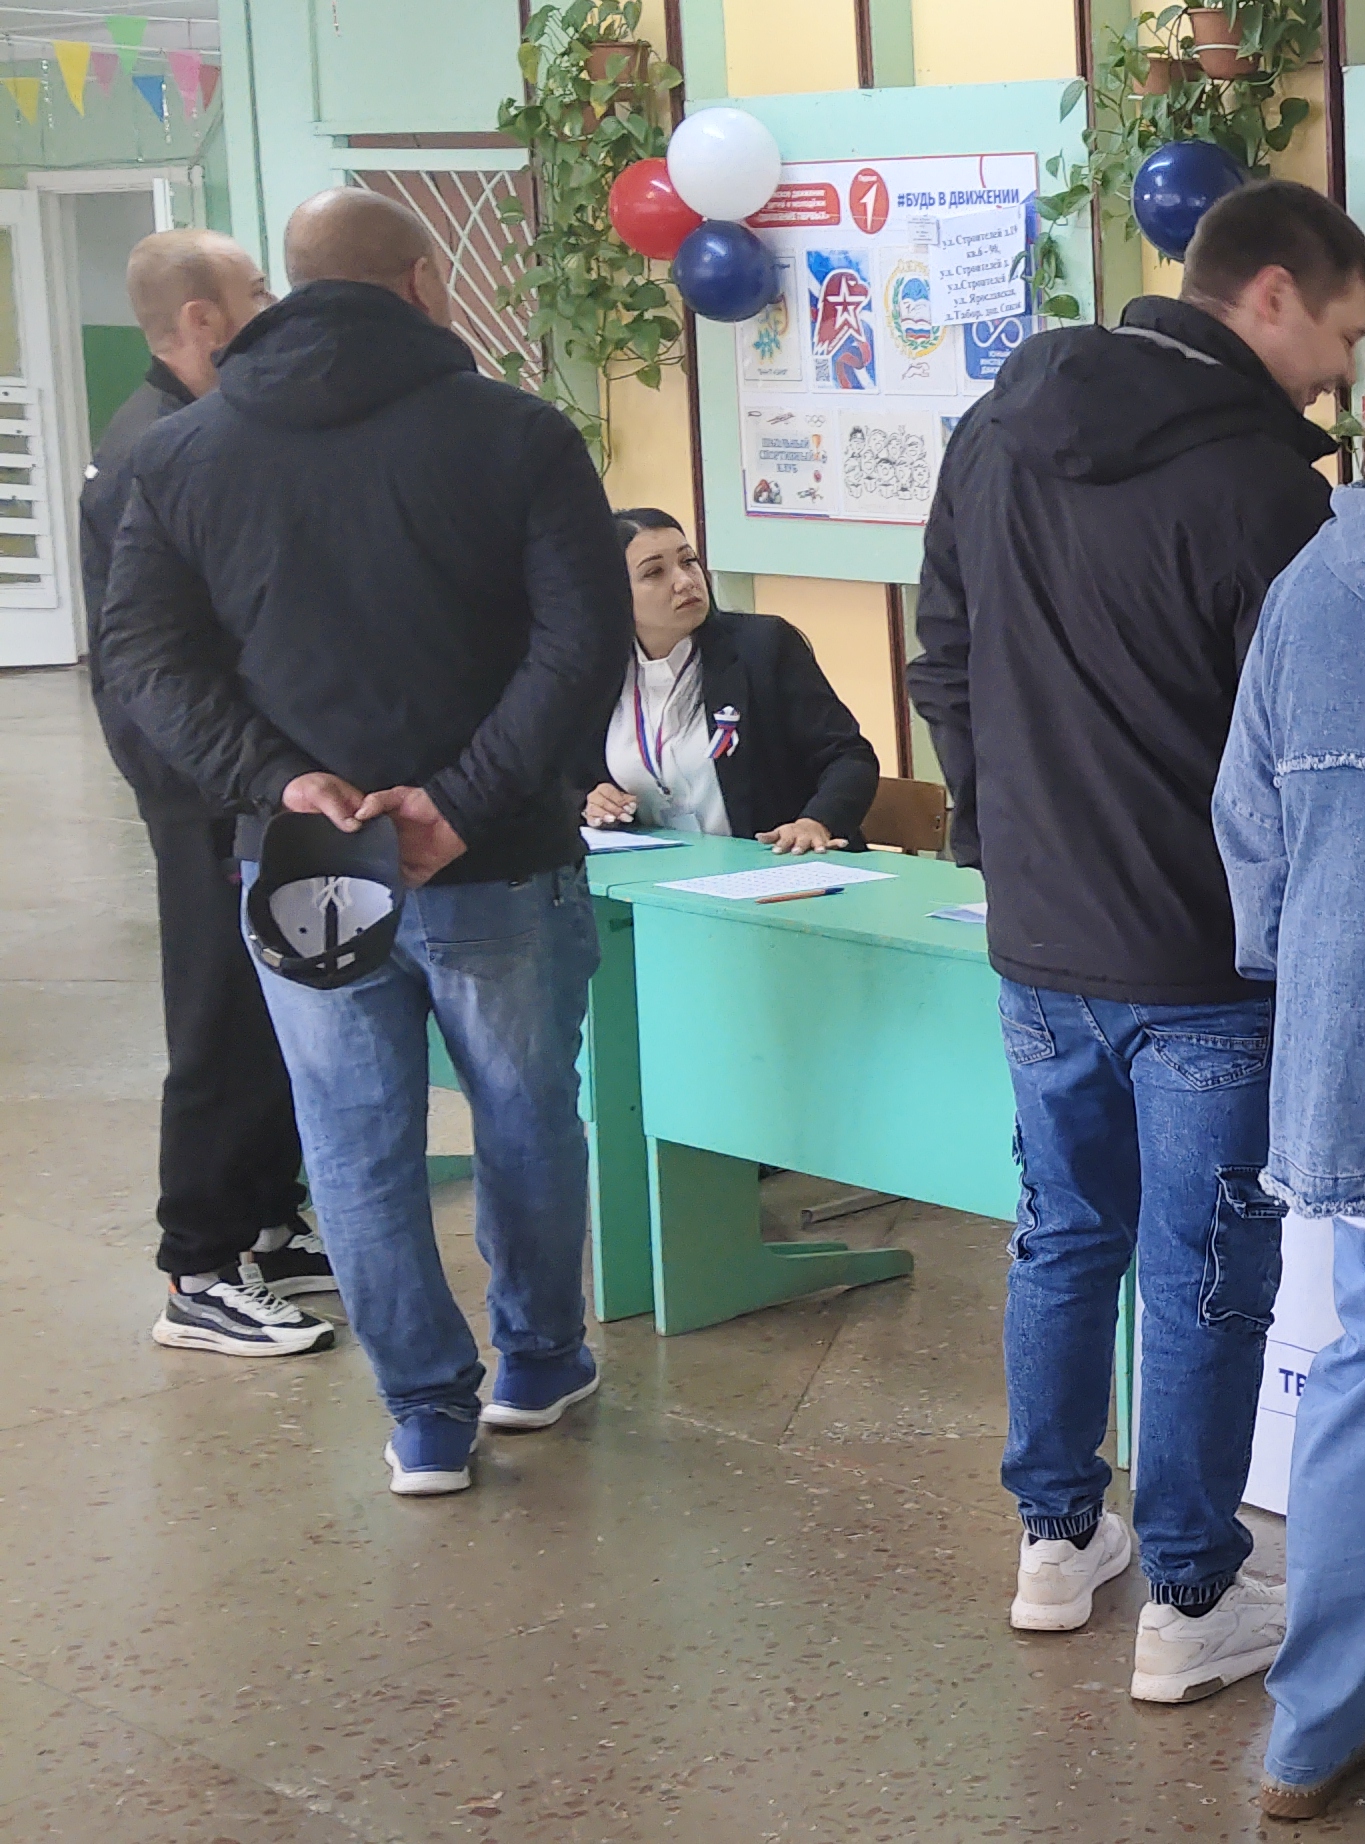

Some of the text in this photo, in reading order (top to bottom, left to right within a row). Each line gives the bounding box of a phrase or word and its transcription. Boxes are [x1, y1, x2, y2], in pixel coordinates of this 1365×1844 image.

[897, 189, 1020, 210] #БУДЬ В ДВИЖЕНИИ
